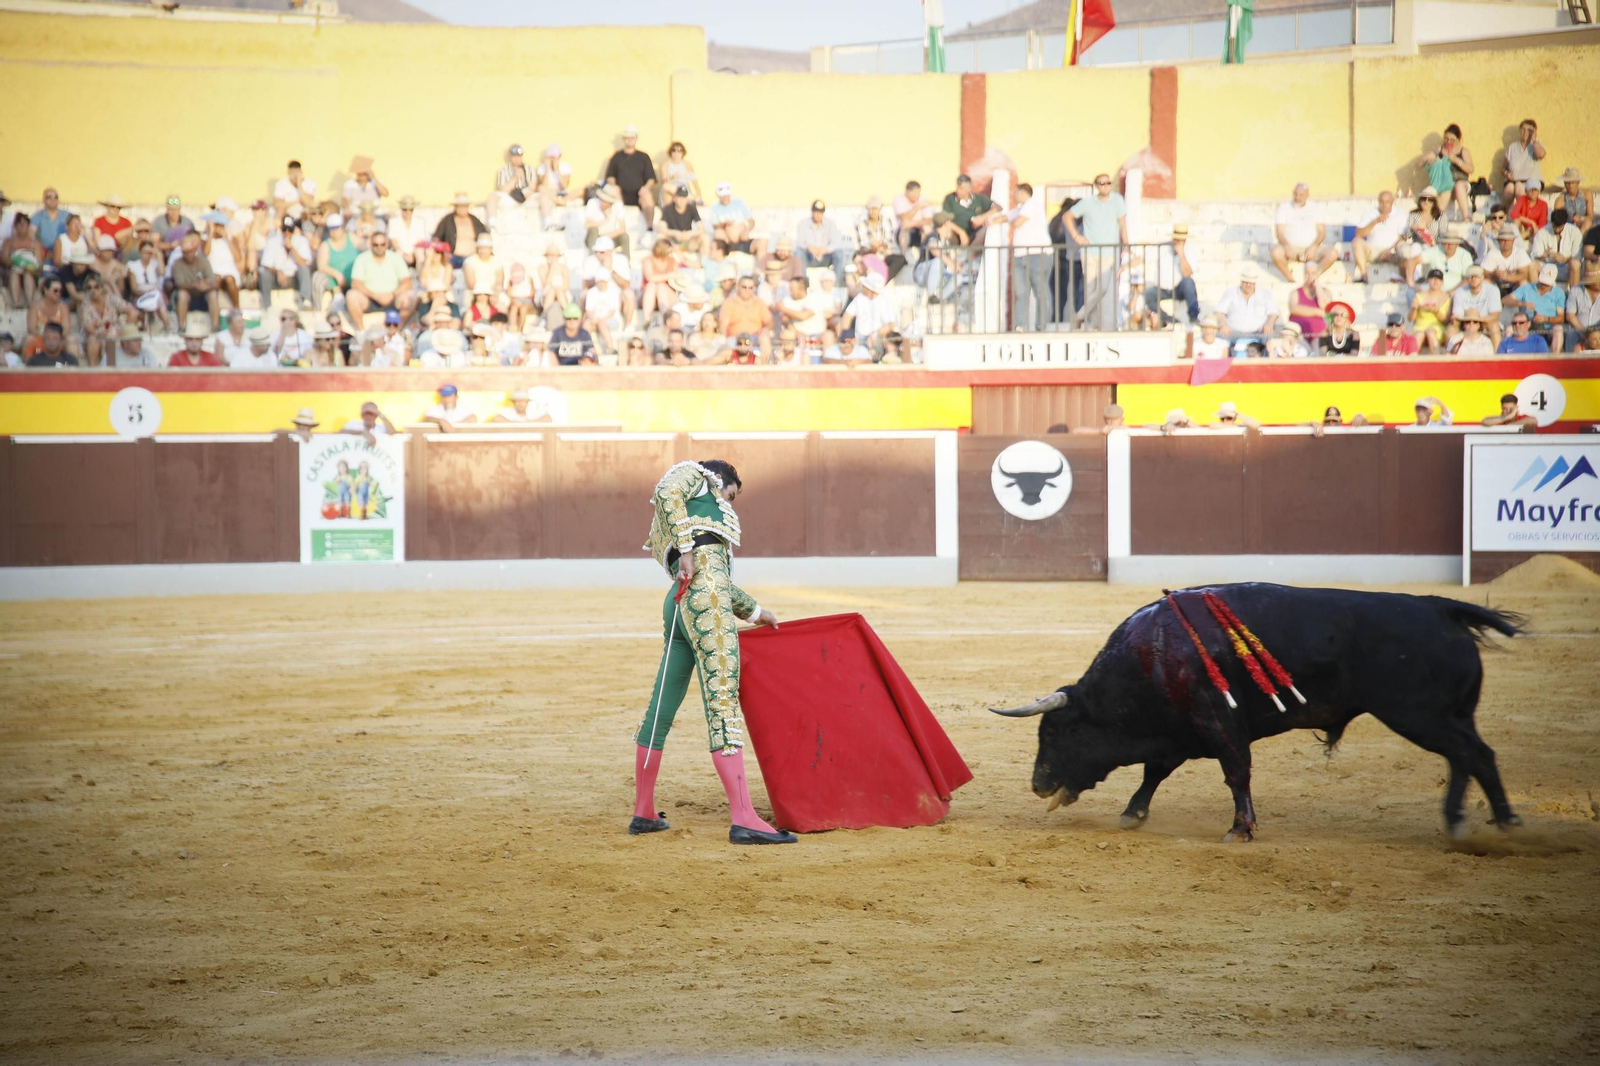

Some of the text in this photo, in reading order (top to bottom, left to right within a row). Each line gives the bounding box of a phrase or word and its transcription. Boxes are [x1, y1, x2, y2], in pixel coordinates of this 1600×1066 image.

[975, 341, 1121, 363] TORILES
[1530, 390, 1548, 411] 4
[128, 403, 143, 423] 5
[306, 441, 351, 483] CASTALA
[1508, 532, 1600, 541] OBRAS Y SERVICIOS
